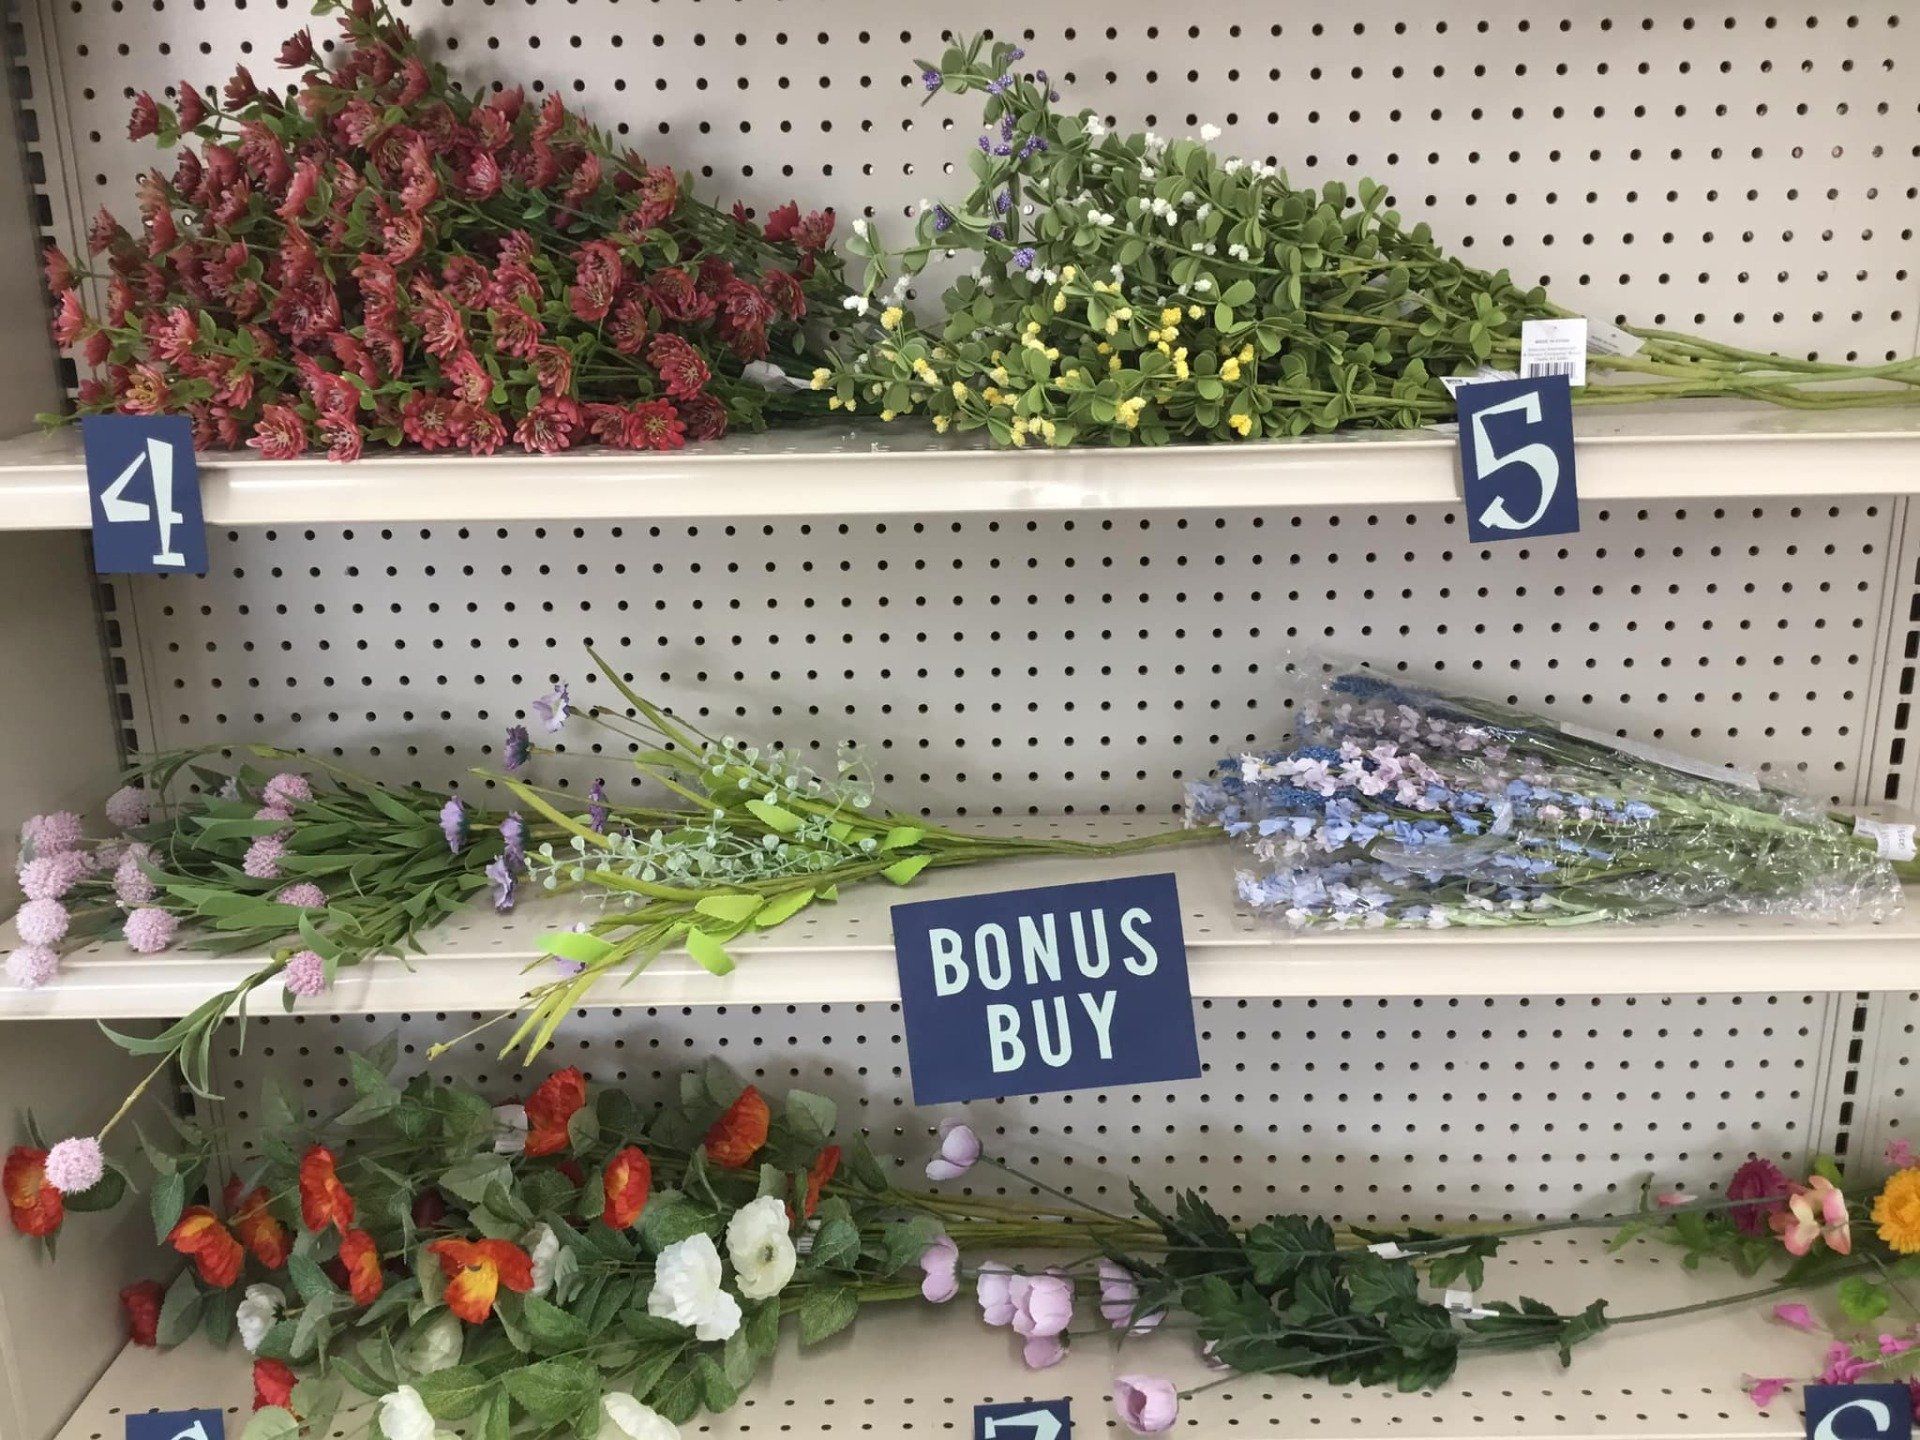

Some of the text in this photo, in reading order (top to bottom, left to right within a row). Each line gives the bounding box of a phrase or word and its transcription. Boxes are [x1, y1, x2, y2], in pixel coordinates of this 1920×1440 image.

[100, 437, 186, 567] 4
[1471, 391, 1560, 531] 5
[928, 907, 1158, 997] BONUS
[986, 990, 1117, 1073] BUY
